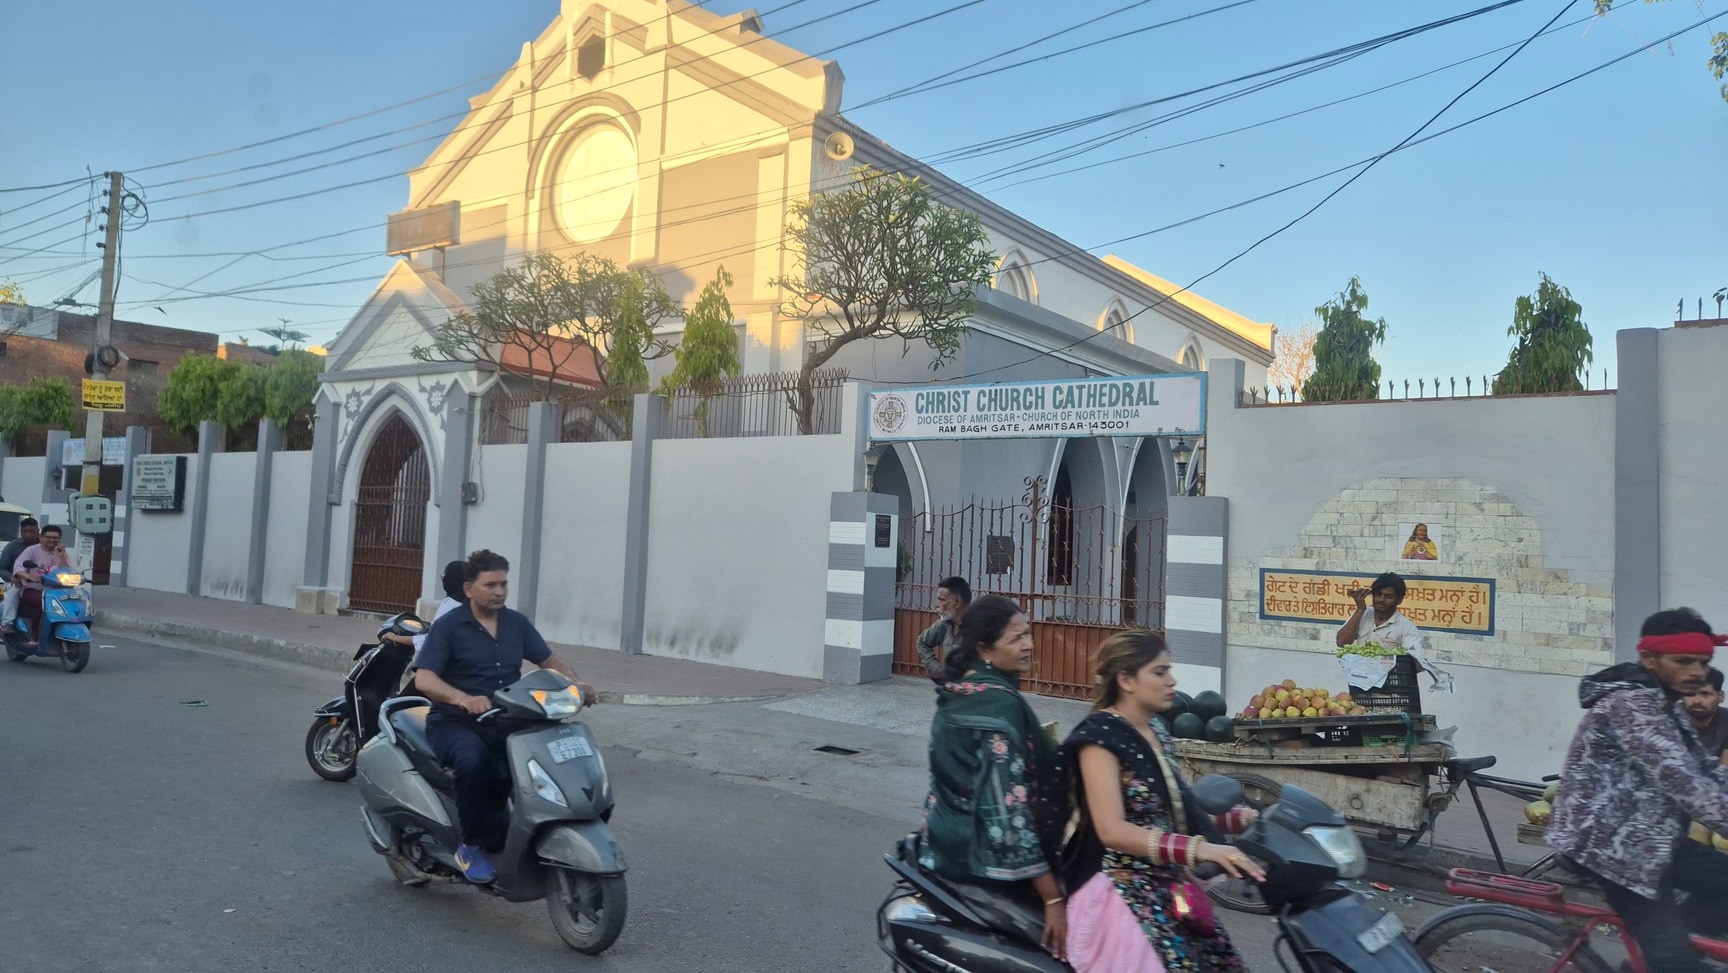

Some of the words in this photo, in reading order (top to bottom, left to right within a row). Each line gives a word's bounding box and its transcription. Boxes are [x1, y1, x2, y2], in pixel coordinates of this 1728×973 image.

[915, 390, 970, 414] CHRIST
[976, 386, 1045, 412] CHURCH
[1052, 381, 1159, 410] CATHEDRAL
[917, 415, 954, 425] DIOCESE
[957, 414, 967, 424] OF
[1060, 411, 1072, 421] OF
[1076, 409, 1109, 420] NORTH
[1112, 409, 1140, 420] INDIA
[960, 424, 987, 433] BAGH
[1266, 576, 1287, 592] ਗੇਟ
[1289, 577, 1299, 594] ਦੇ
